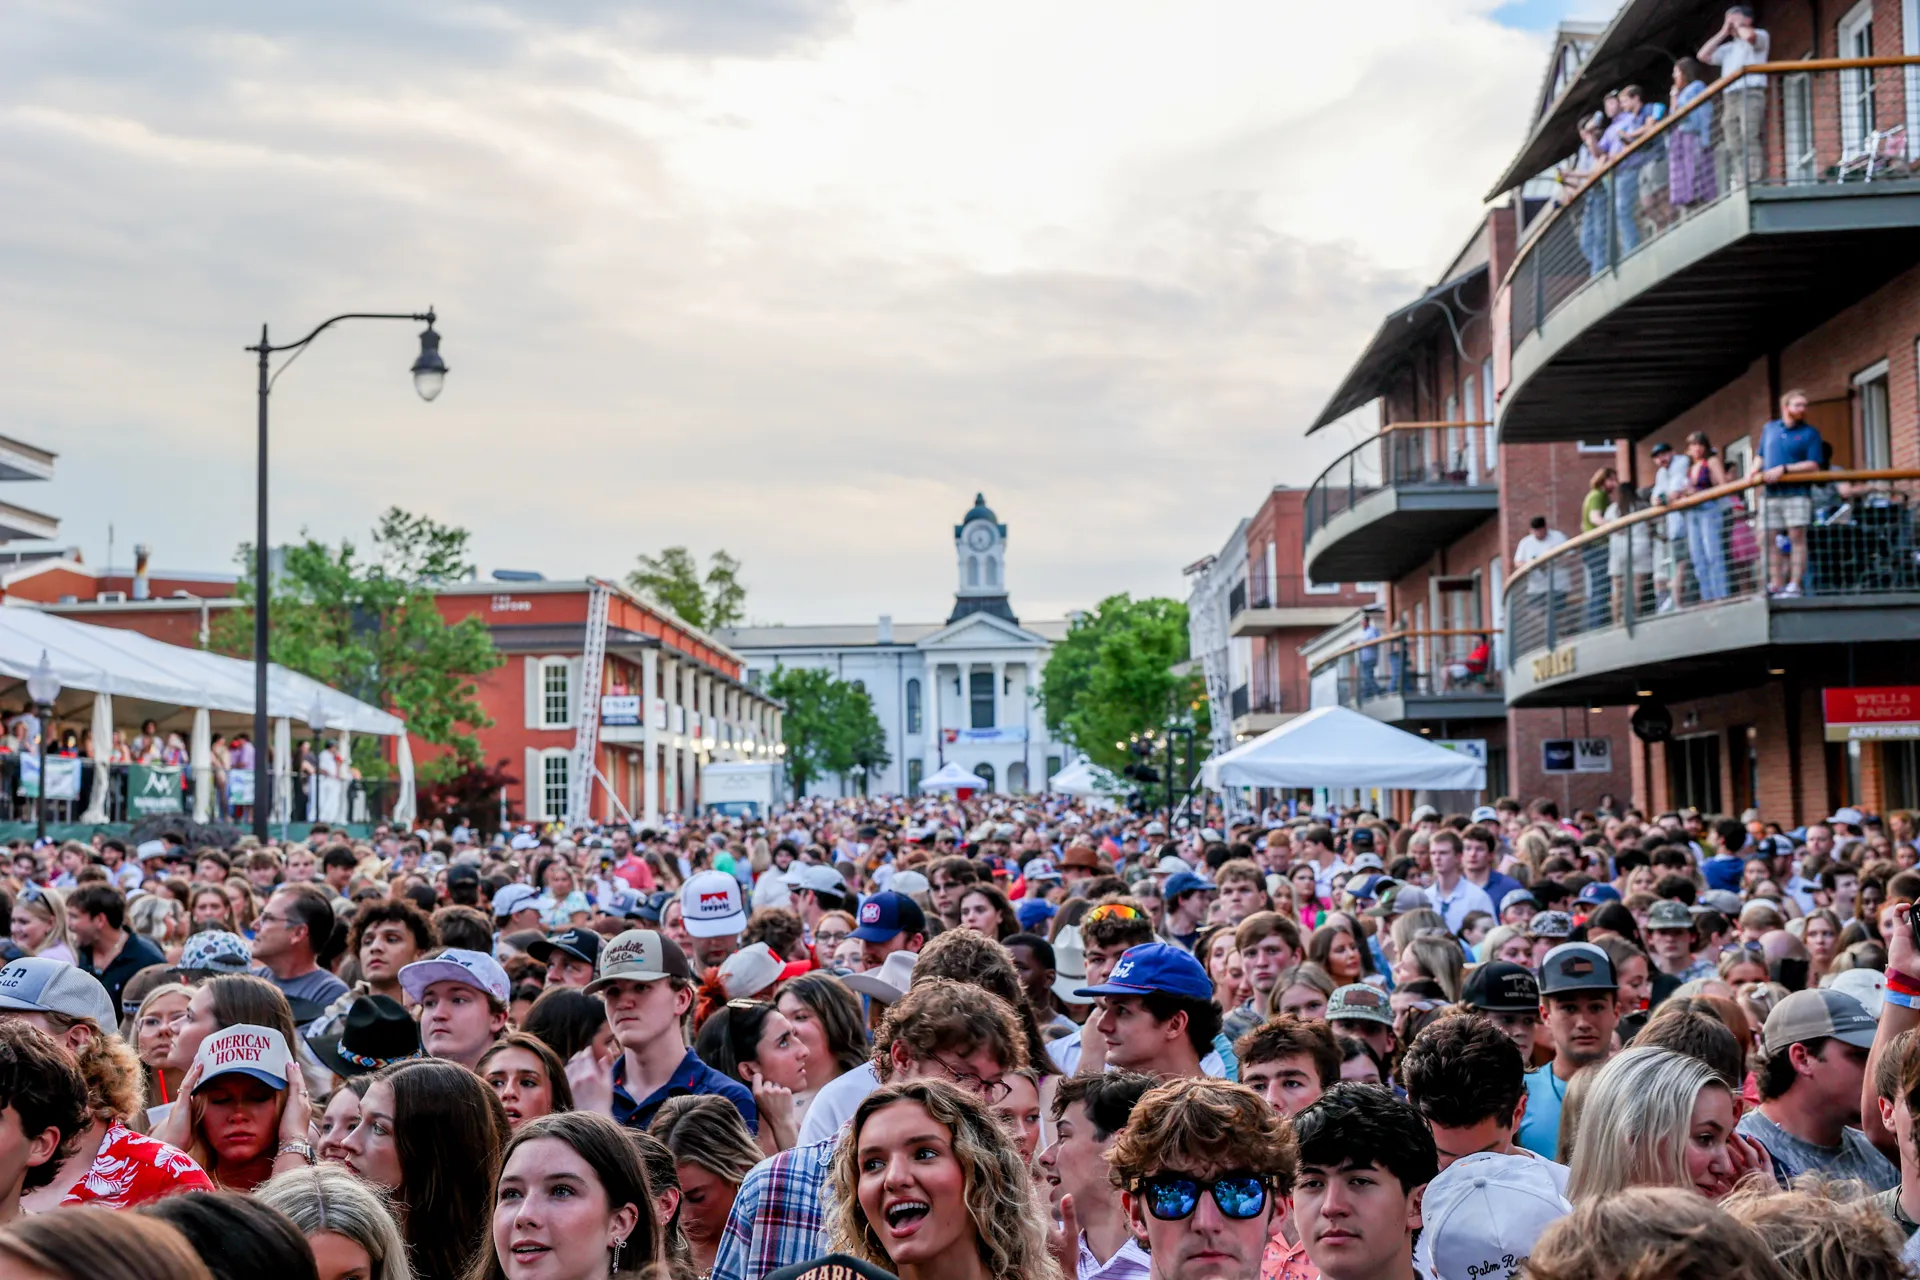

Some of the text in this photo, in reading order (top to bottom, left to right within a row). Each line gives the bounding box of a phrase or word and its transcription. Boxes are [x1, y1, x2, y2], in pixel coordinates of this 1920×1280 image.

[1854, 693, 1911, 705] WELLS
[1856, 706, 1911, 718] FARGO
[208, 1034, 271, 1056] AMERICAN
[215, 1047, 262, 1066] HONEY
[1467, 1260, 1501, 1280] Palm
